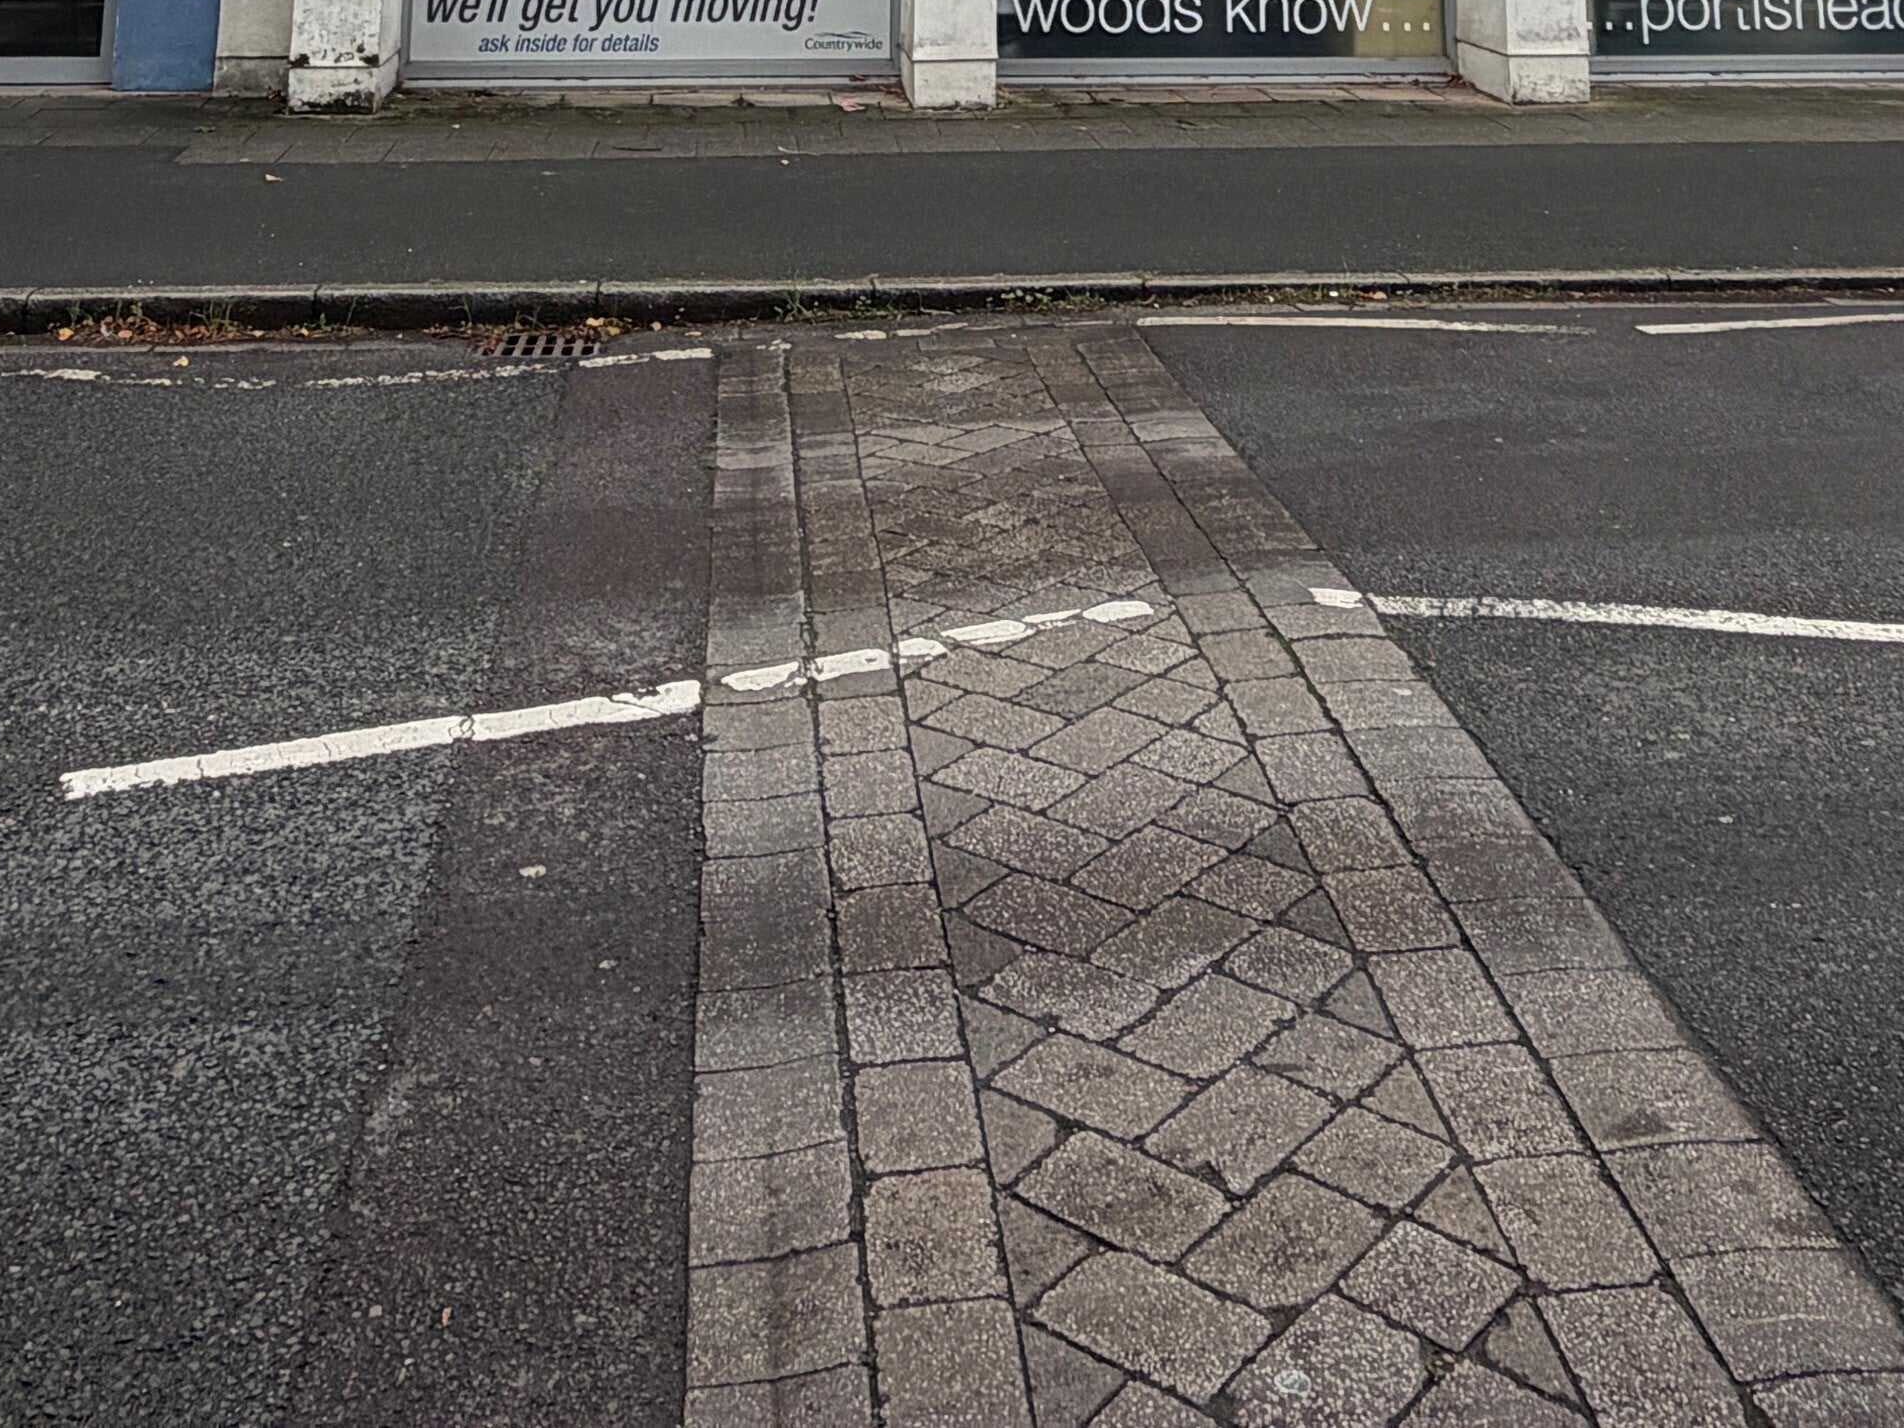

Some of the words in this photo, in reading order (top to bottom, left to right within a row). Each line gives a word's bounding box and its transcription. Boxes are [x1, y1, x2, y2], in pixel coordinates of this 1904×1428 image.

[478, 34, 510, 53] ask
[514, 34, 568, 53] inside
[572, 34, 598, 53] for
[601, 34, 660, 53] details
